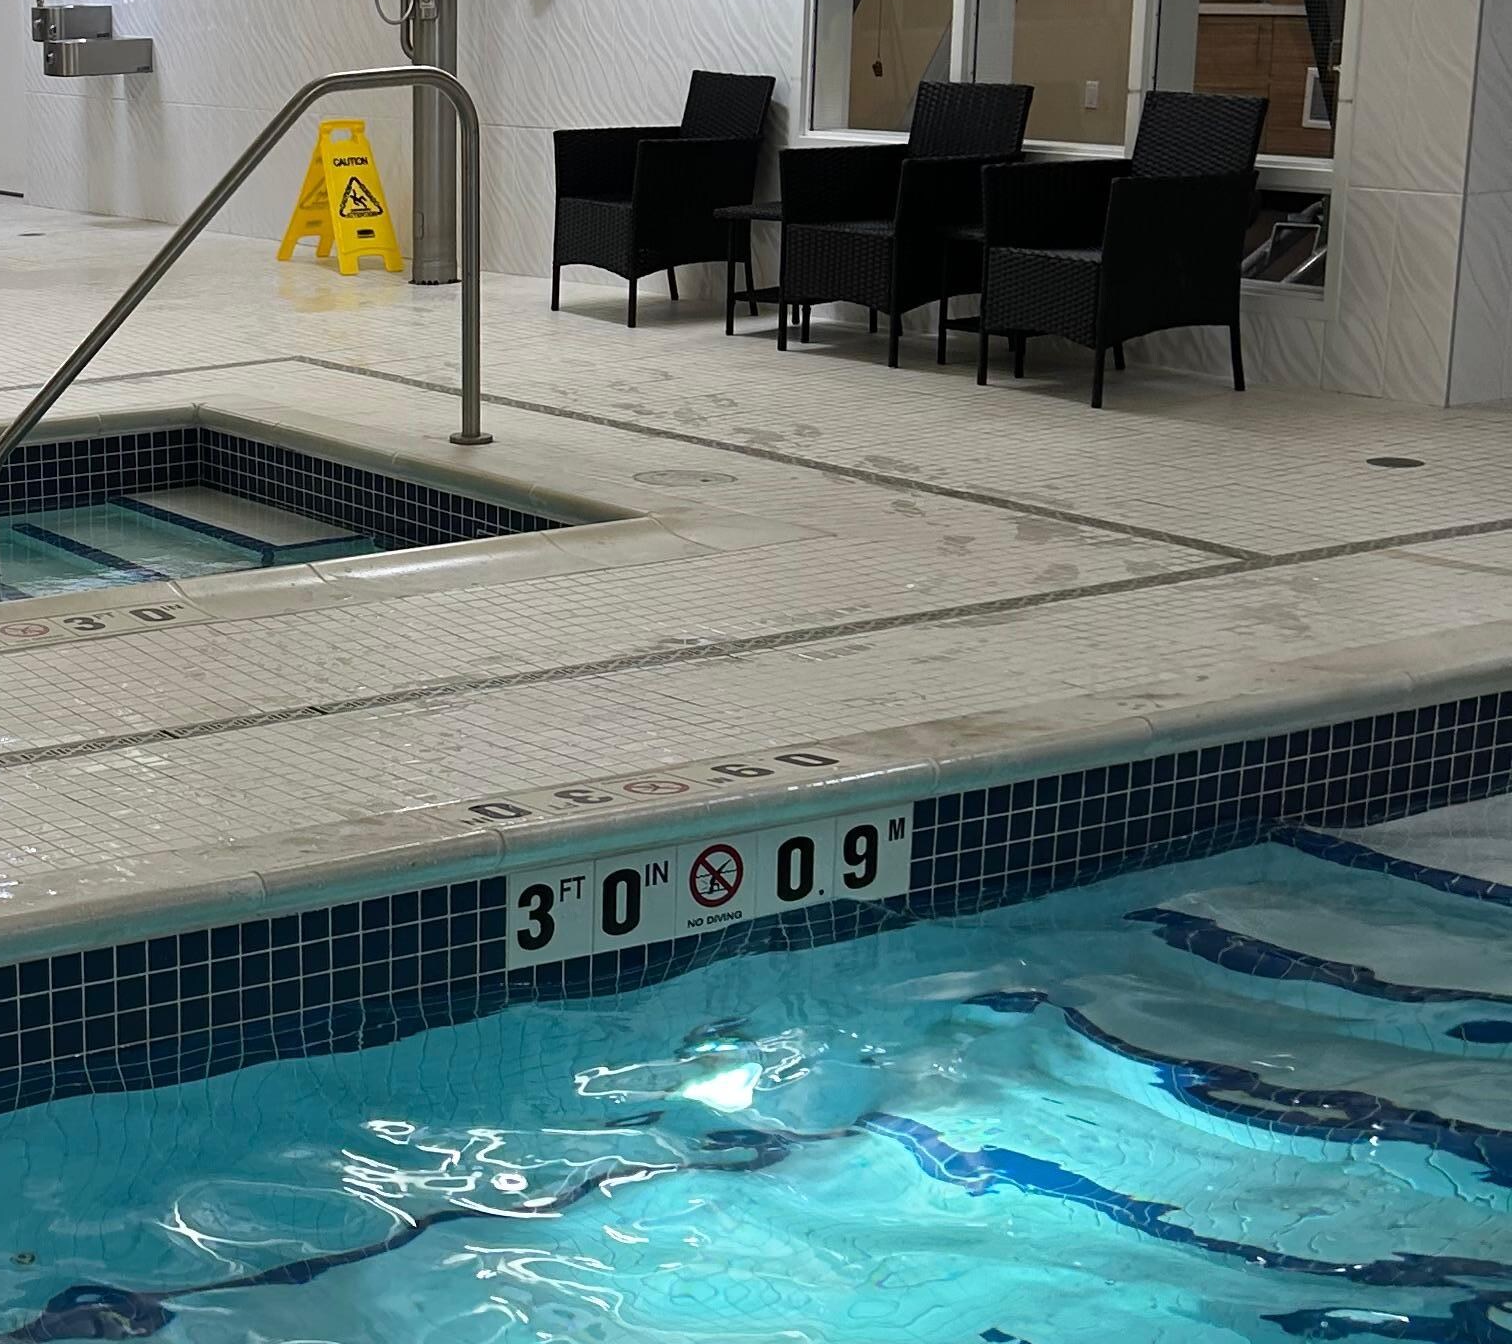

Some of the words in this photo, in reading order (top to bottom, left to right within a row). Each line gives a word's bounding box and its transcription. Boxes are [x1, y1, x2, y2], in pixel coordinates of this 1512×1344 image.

[333, 157, 368, 167] CAUTION
[687, 917, 703, 929] NO
[706, 910, 743, 925] DIVING
